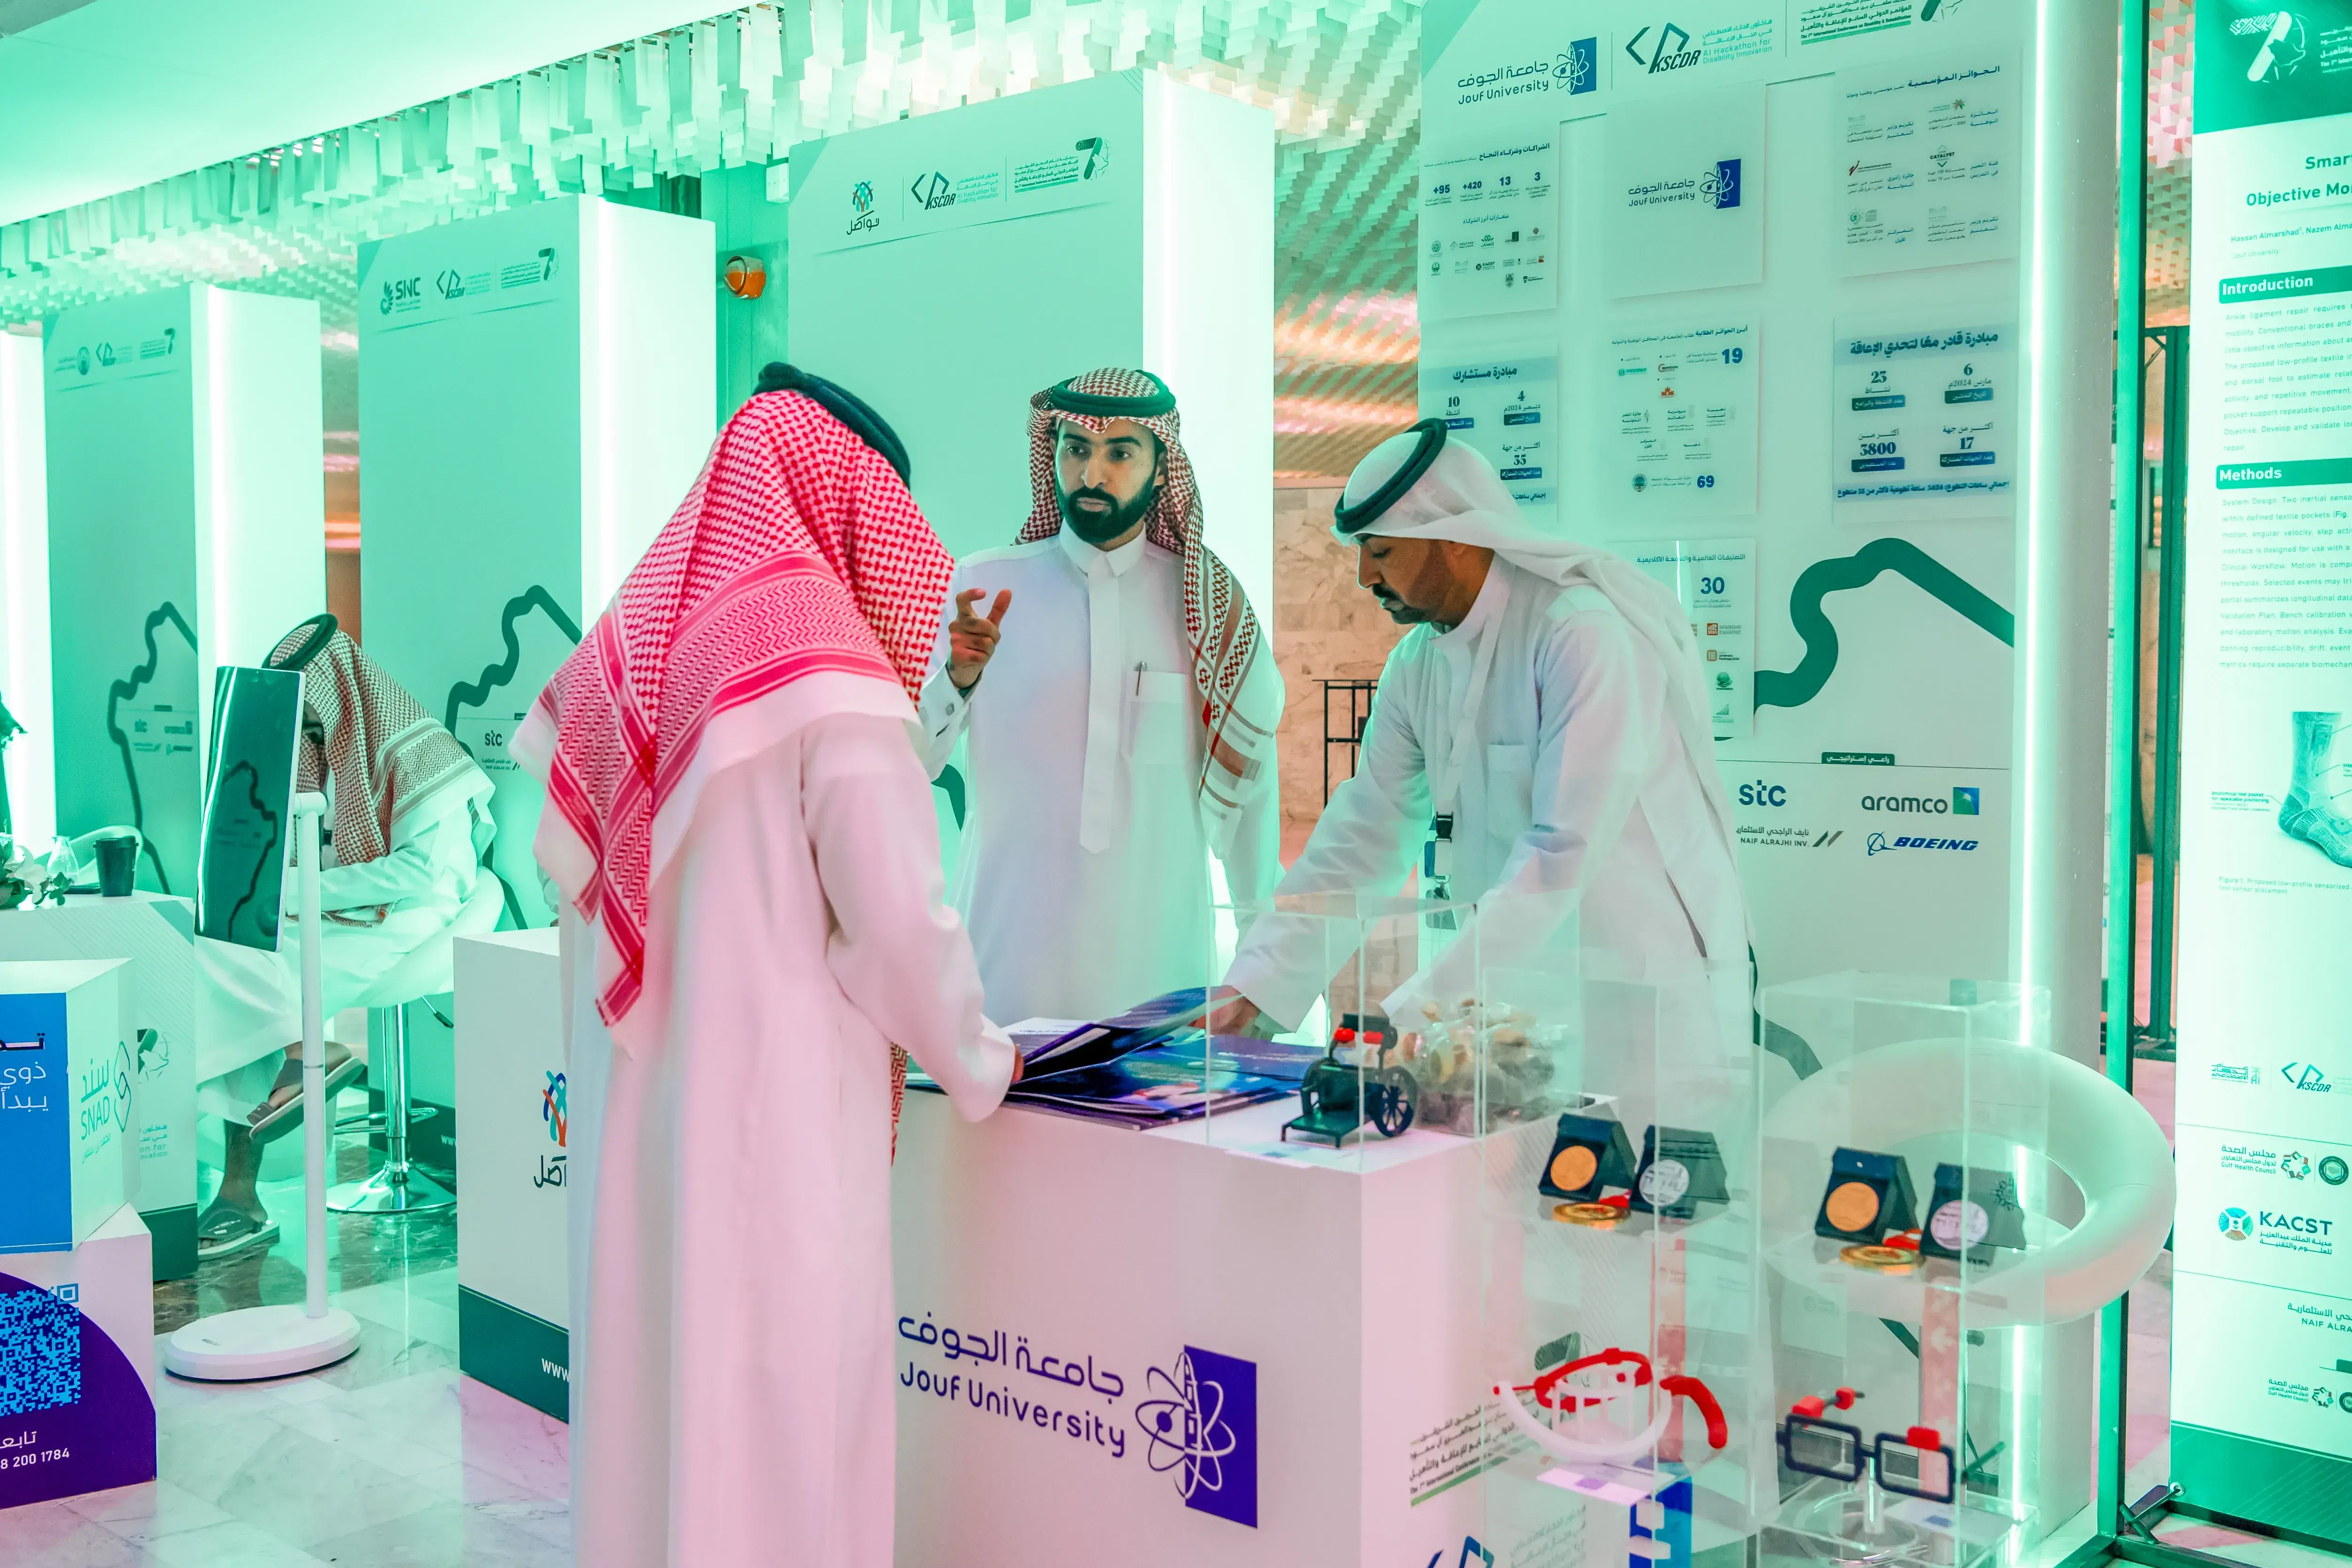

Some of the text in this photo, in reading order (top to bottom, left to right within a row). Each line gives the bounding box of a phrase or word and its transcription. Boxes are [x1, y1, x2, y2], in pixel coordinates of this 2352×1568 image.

[1869, 9, 1888, 19] الدولي
[1703, 47, 1772, 63] Disability Innovation
[1715, 41, 1756, 55] Hackathon
[1648, 50, 1701, 74] KSCDR
[1458, 61, 1548, 87] جامعة الجوف
[1908, 66, 2000, 88] الجوائز المؤسسية
[1459, 80, 1548, 105] Jouf University
[1523, 143, 1549, 152] الشراكات
[1479, 151, 1498, 161] النجاح
[1500, 176, 1511, 186] 13
[1534, 172, 1540, 181] 3
[1629, 179, 1695, 195] جامعة الجوف
[1629, 192, 1695, 206] Jouf University
[2247, 182, 2352, 207] Objective Mo
[924, 194, 956, 210] KSCDR
[847, 210, 880, 235] تواصل
[396, 277, 421, 300] SNC
[2222, 276, 2313, 295] Introduction
[2250, 304, 2345, 320] ligament repair requires
[2258, 323, 2306, 334] Conventional
[2309, 320, 2334, 329] braces
[1941, 331, 1962, 350] قادر
[1965, 332, 1998, 347] مبادرة
[2243, 344, 2275, 353] objective
[2277, 339, 2320, 349] information
[1851, 341, 1882, 356] الإعاقة
[1884, 338, 1917, 358] لتحدي
[1721, 348, 1743, 364] 19
[2241, 359, 2274, 370] proposed
[2277, 356, 2318, 366] low-profile
[1453, 366, 1517, 383] مبادرة مستشارك
[1963, 363, 1973, 375] 6
[1871, 371, 1887, 383] 23
[1448, 397, 1460, 407] 10
[1517, 391, 1525, 401] 4
[1860, 442, 1896, 456] 3800
[1960, 437, 1974, 450] 17
[1514, 454, 1526, 465] 35
[2220, 467, 2282, 481] Methods
[1697, 475, 1714, 488] 69
[2301, 512, 2330, 520] pockets
[2333, 510, 2349, 519] (Fig.
[1700, 577, 1725, 594] 30
[485, 730, 502, 746] stc
[1739, 780, 1786, 807] stc
[1861, 795, 1947, 814] aramco
[1736, 826, 1764, 834] الاستثماري
[1893, 836, 1978, 851] BOEING
[2278, 880, 2312, 888] low-profile
[81, 1059, 109, 1103] سند
[2297, 1082, 2331, 1092] KSCDR
[81, 1096, 109, 1140] SNAD
[2222, 1145, 2276, 1159] مجلس الصحة
[2260, 1211, 2333, 1235] KACST
[2260, 1230, 2289, 1240] عبدالعزيز
[2260, 1239, 2297, 1250] والتقنية
[2288, 1303, 2332, 1317] الاستثمارية
[2302, 1318, 2324, 1327] NAIF
[898, 1311, 1124, 1404] جامعة الجوف
[2269, 1378, 2287, 1387] الصحة
[900, 1361, 1125, 1458] Jouf University
[13, 1447, 70, 1468] 200 1784
